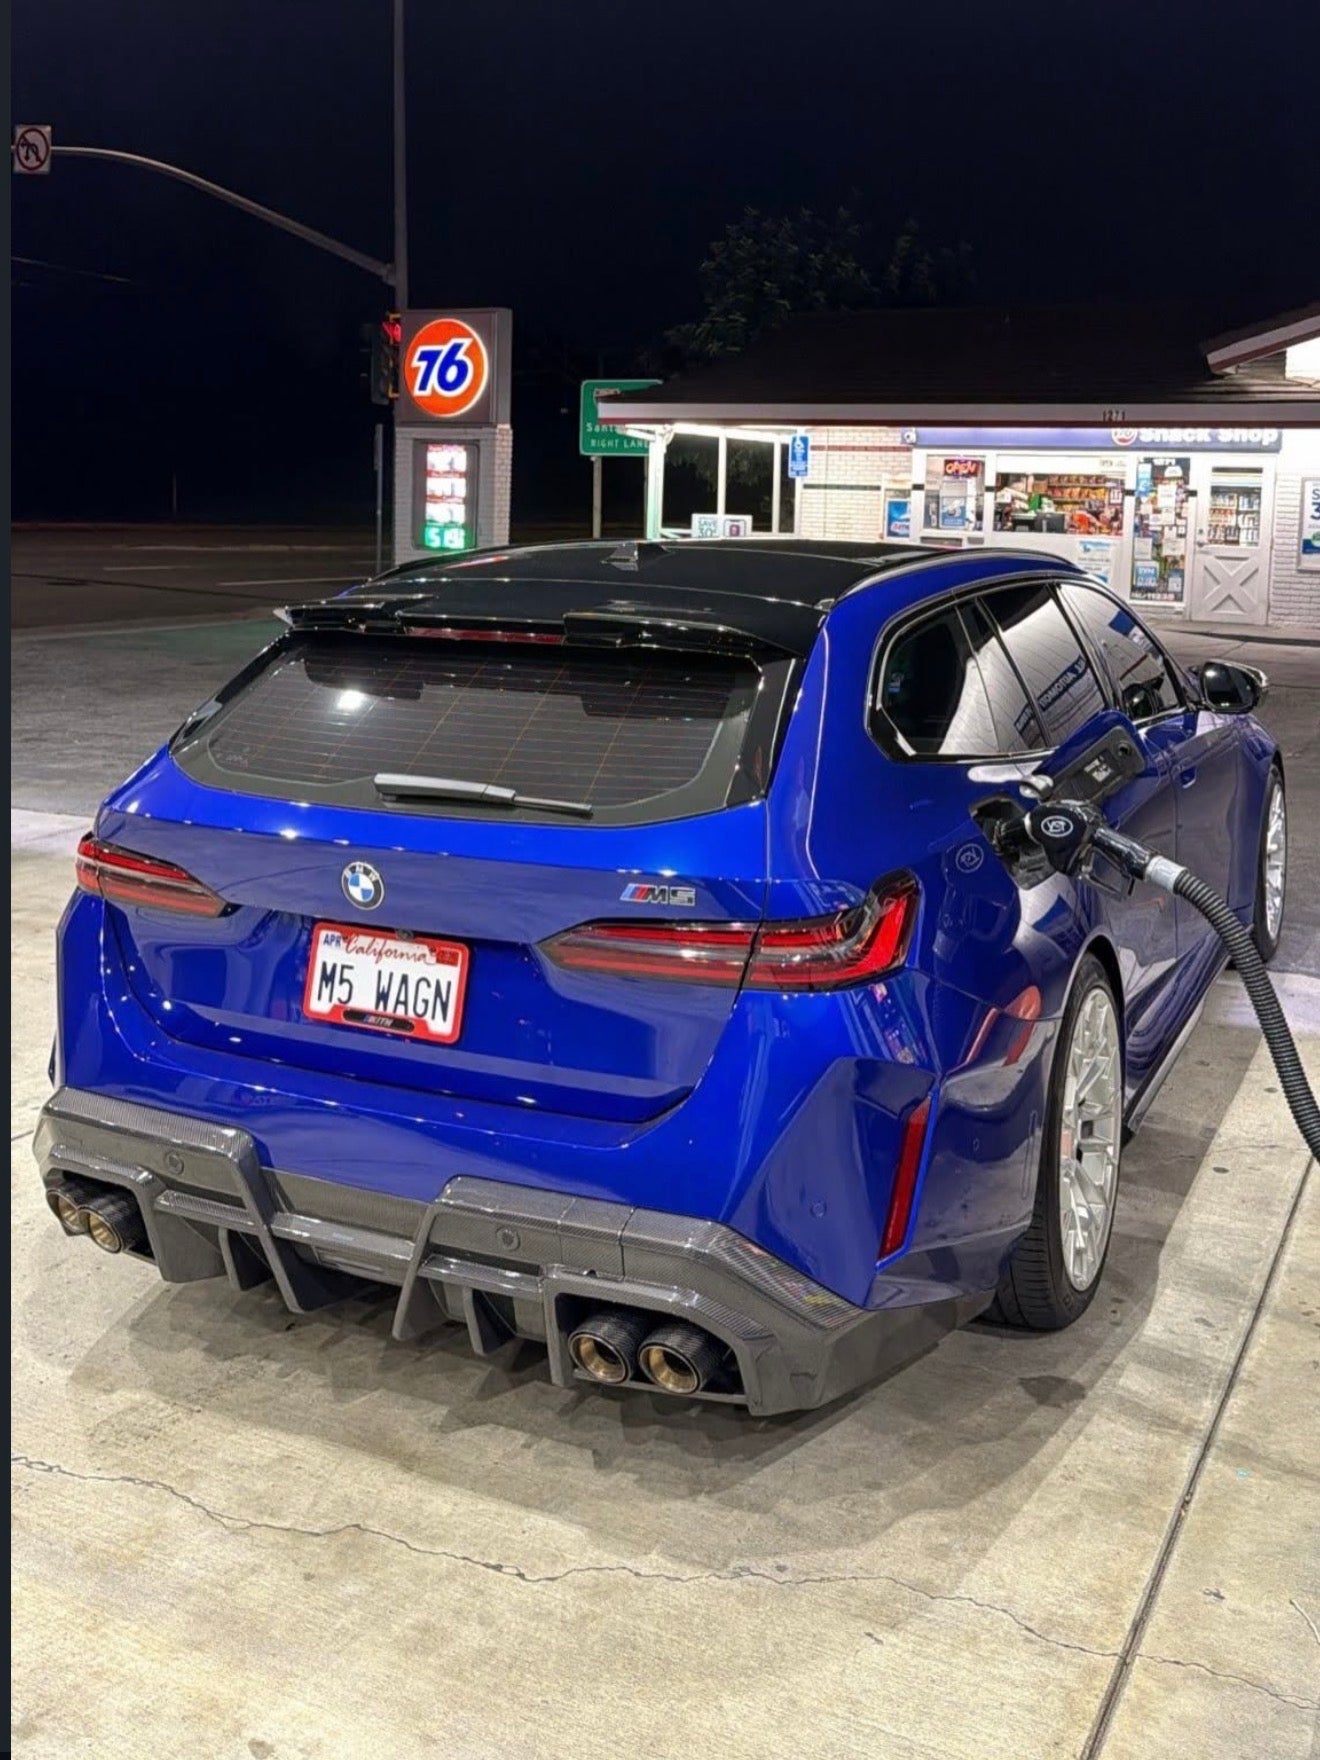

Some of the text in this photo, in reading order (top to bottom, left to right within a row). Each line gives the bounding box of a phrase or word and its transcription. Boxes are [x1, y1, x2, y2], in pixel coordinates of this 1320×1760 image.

[414, 340, 470, 394] 76
[1102, 410, 1126, 422] 1271
[591, 439, 619, 447] RIGHT
[1139, 428, 1279, 445] Snack Shop
[945, 461, 977, 474] OPEN
[641, 884, 696, 906] M5
[323, 933, 342, 948] APR
[344, 935, 437, 965] California
[317, 961, 452, 1023] M5 WAGN
